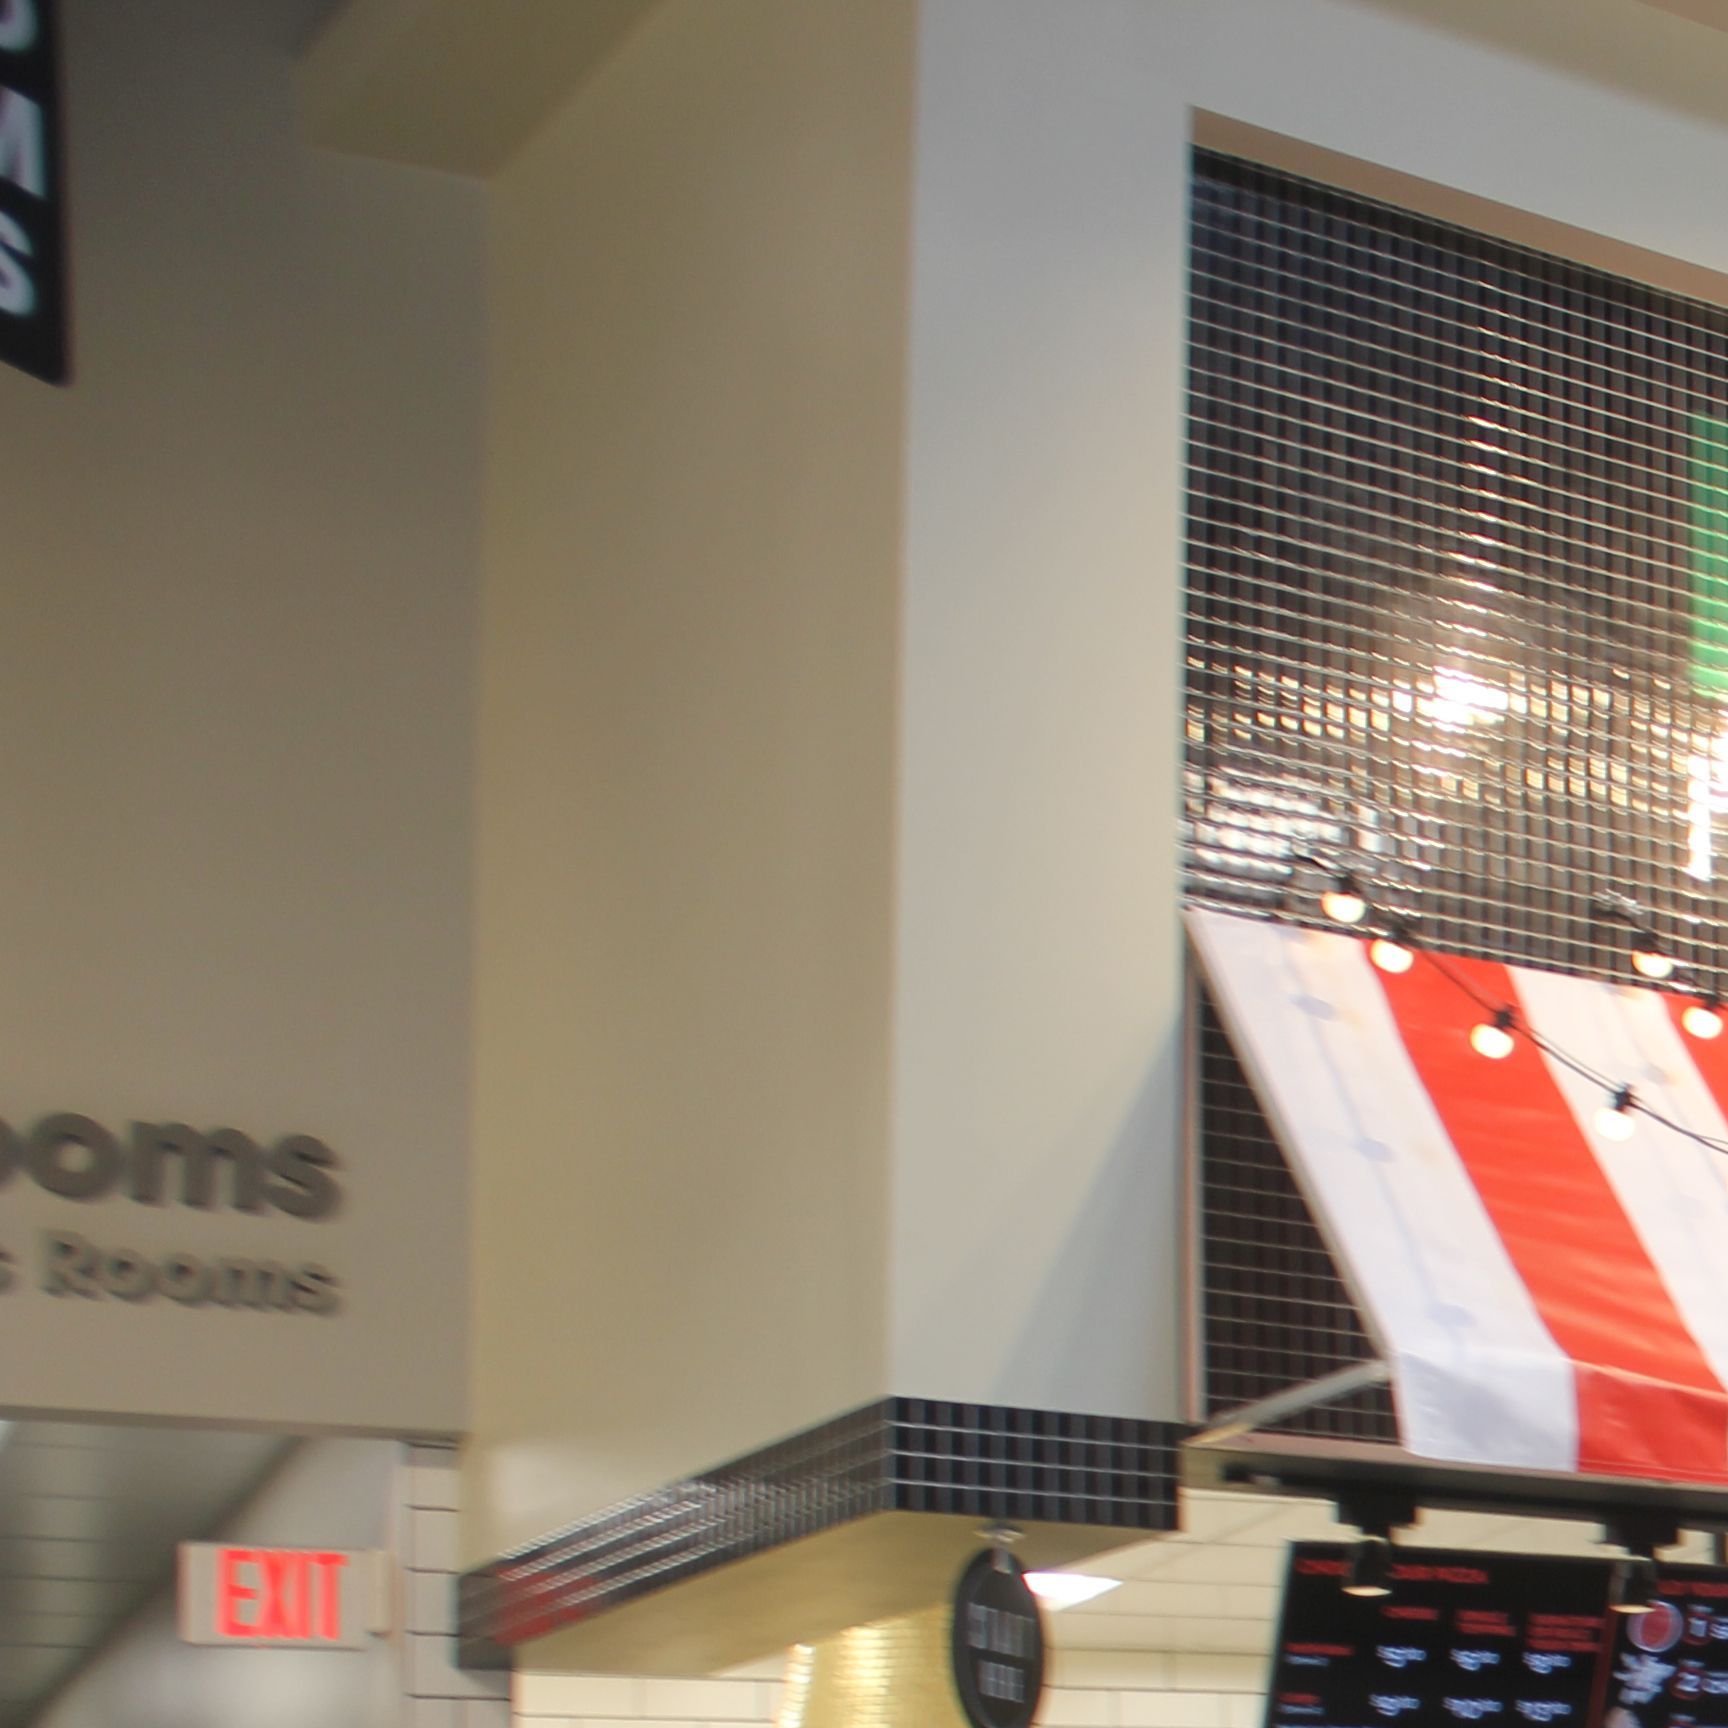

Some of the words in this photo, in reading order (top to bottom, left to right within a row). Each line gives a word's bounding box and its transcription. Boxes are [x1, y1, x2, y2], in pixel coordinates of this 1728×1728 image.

[0, 1110, 342, 1222] oms
[38, 1227, 342, 1317] Rooms
[211, 1547, 351, 1641] EXIT
